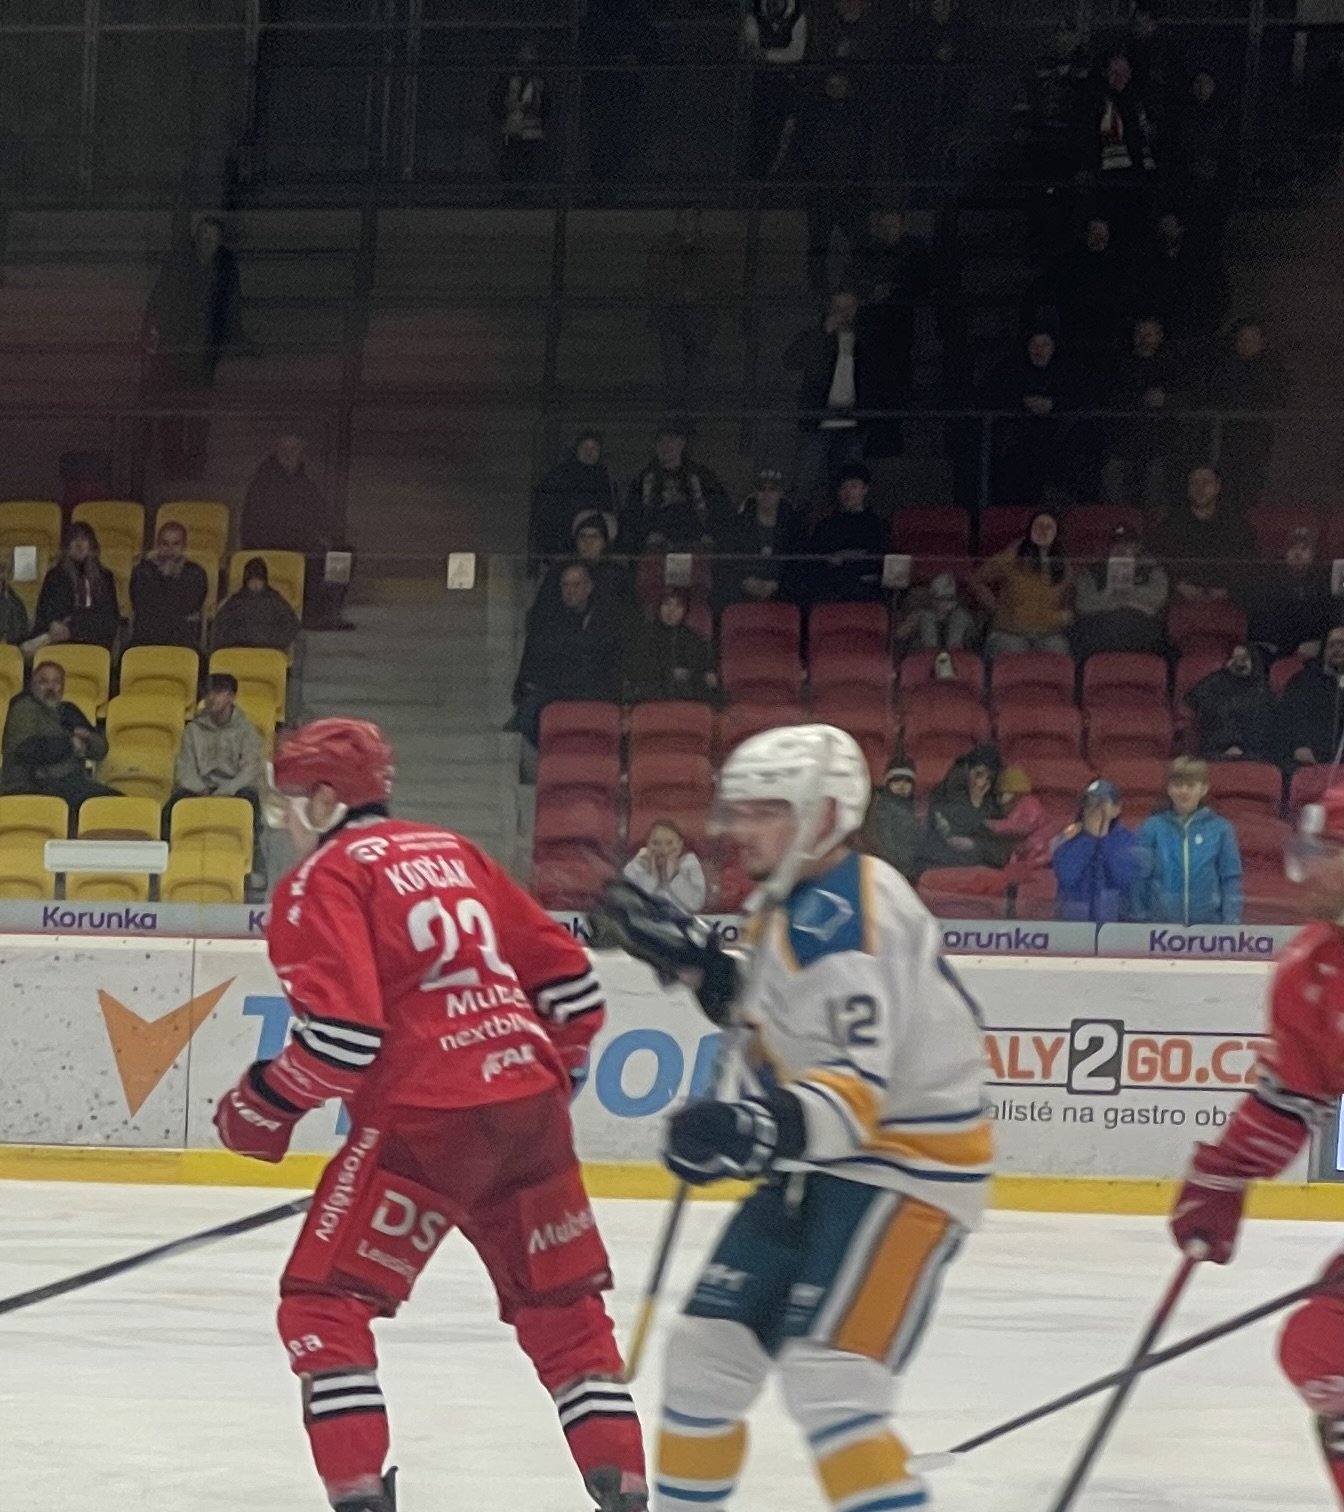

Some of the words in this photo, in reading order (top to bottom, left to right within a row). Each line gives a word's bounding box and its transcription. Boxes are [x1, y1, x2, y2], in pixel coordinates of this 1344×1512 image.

[42, 906, 158, 930] Korunka
[943, 926, 1050, 952] orunka
[1149, 930, 1274, 955] Korunka
[1062, 1105, 1094, 1123] na
[1103, 1105, 1186, 1130] gastro
[370, 1189, 448, 1253] DS
